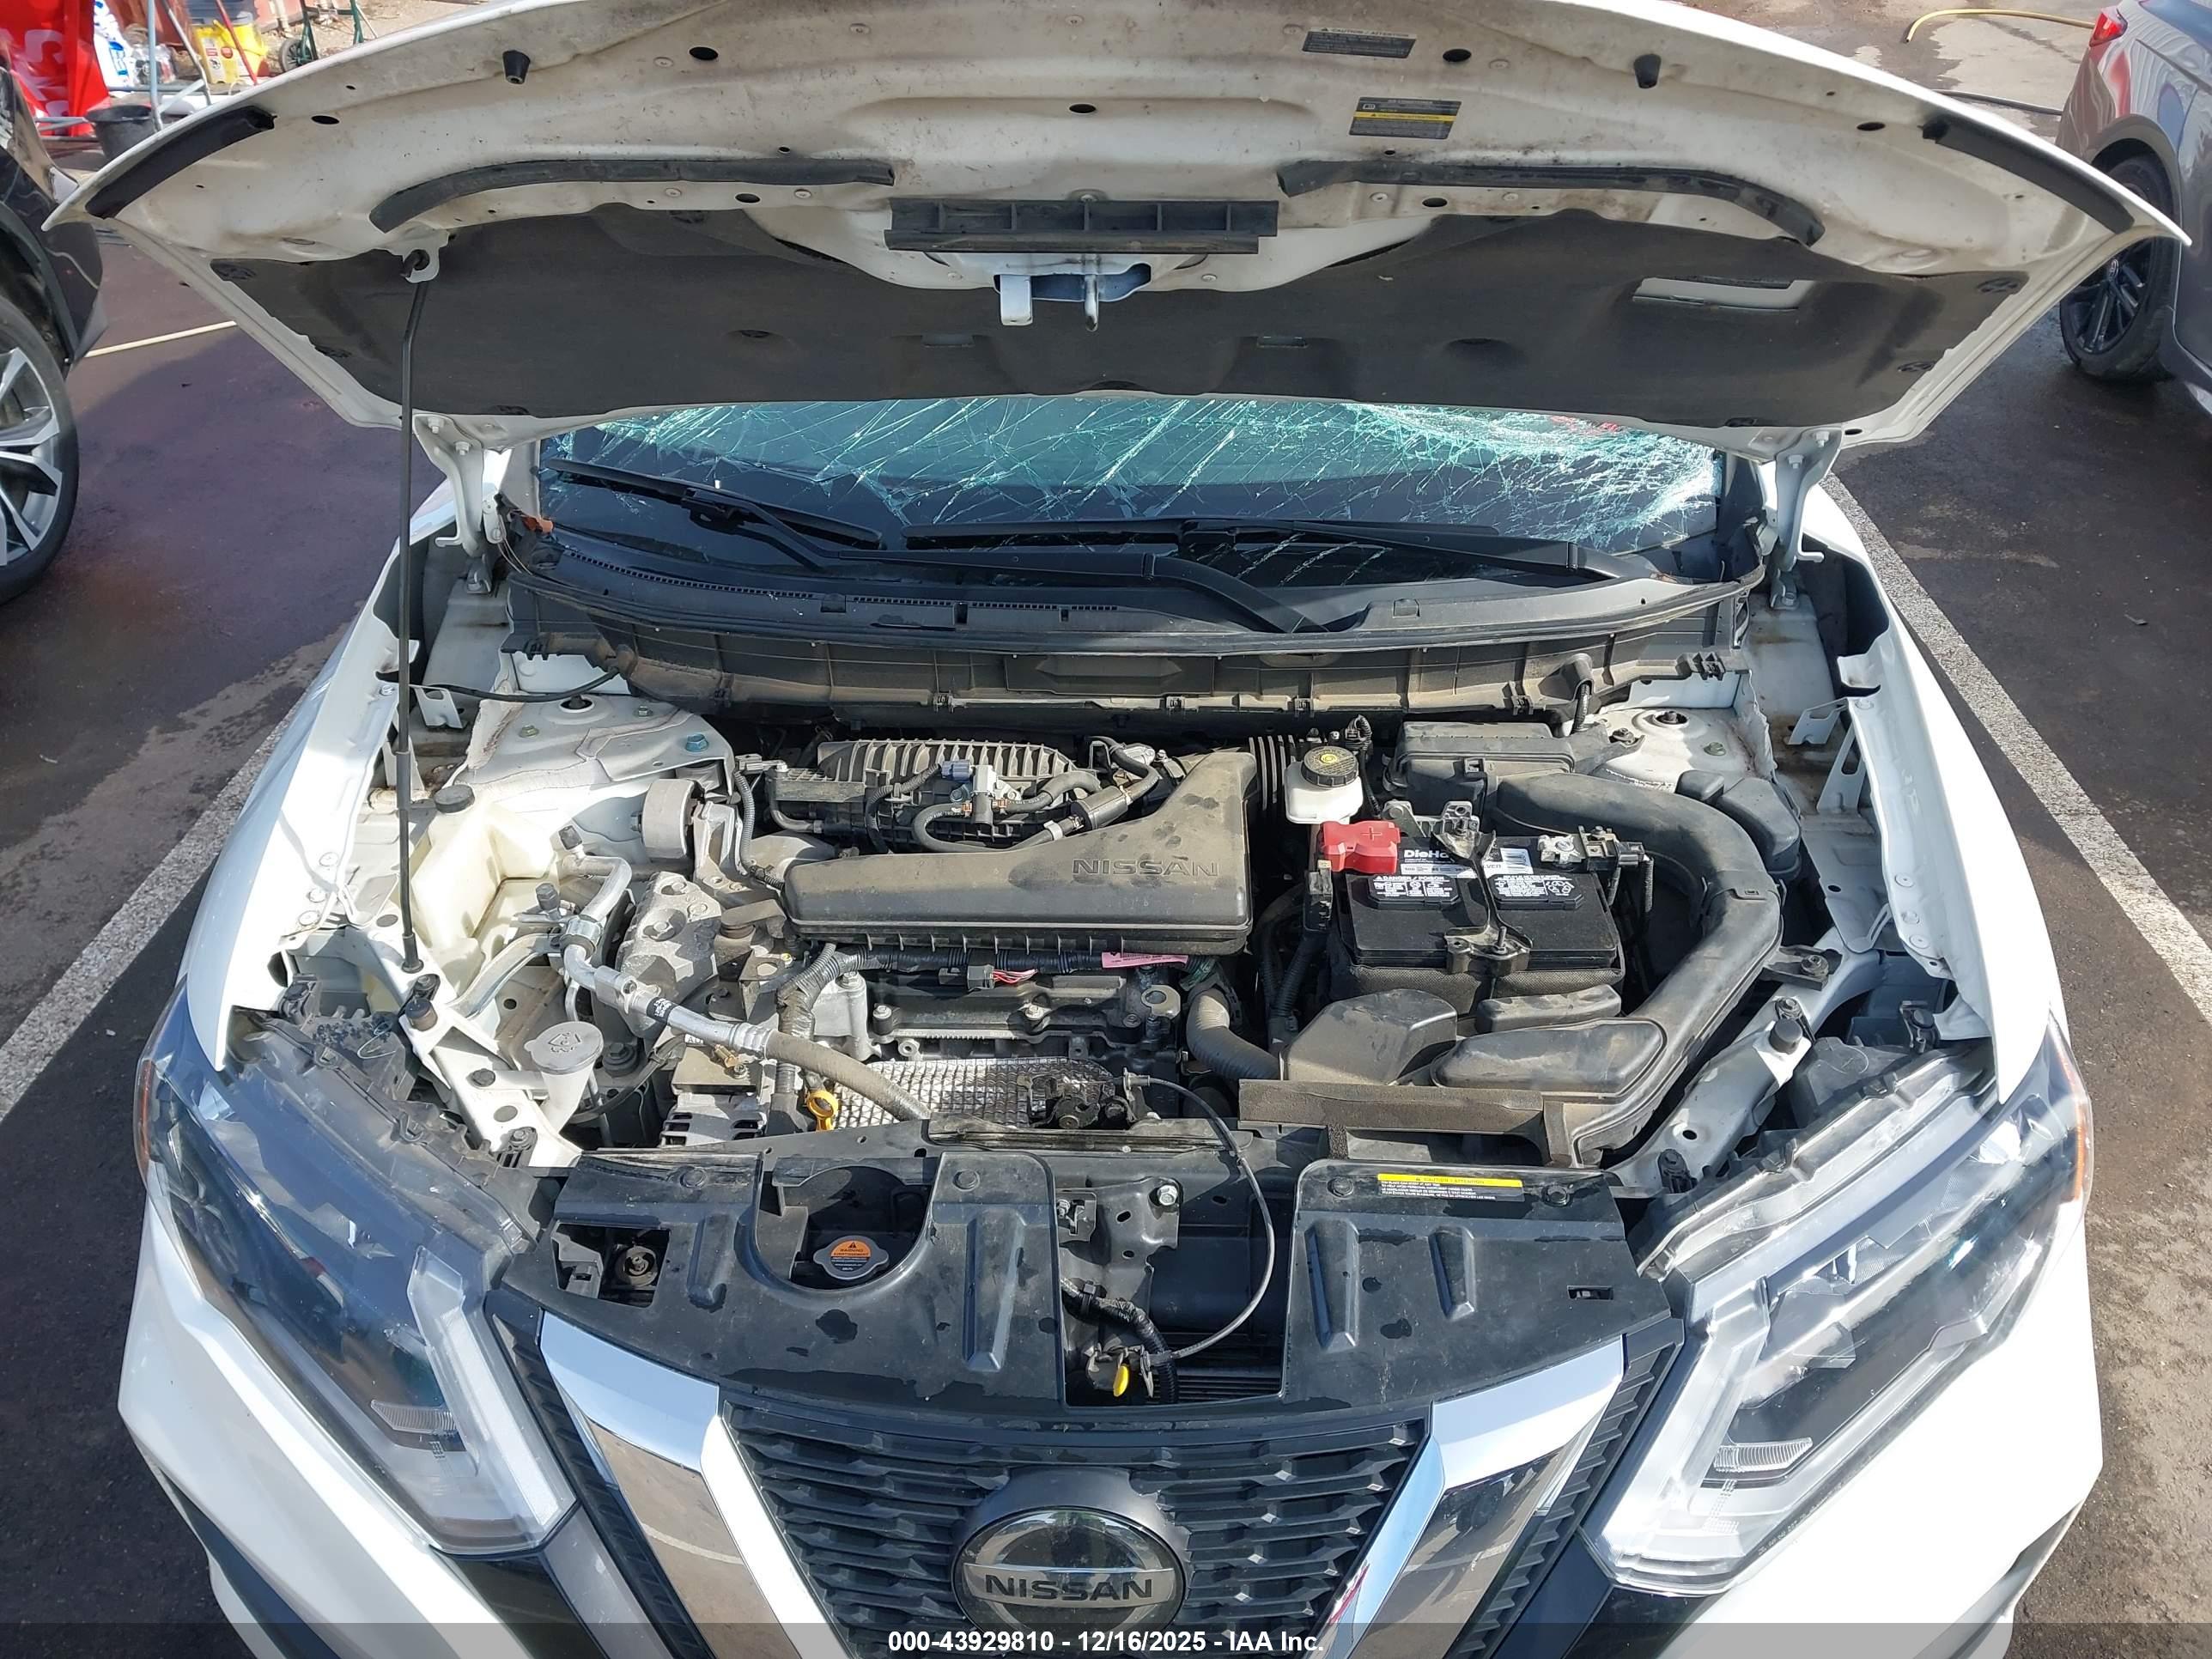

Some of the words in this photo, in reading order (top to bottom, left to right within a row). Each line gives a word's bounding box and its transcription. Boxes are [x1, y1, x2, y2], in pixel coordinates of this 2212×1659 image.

[1404, 849, 1449, 859] DieHa
[1072, 859, 1219, 877] NISSAN
[985, 1573, 1153, 1601] NISSAN
